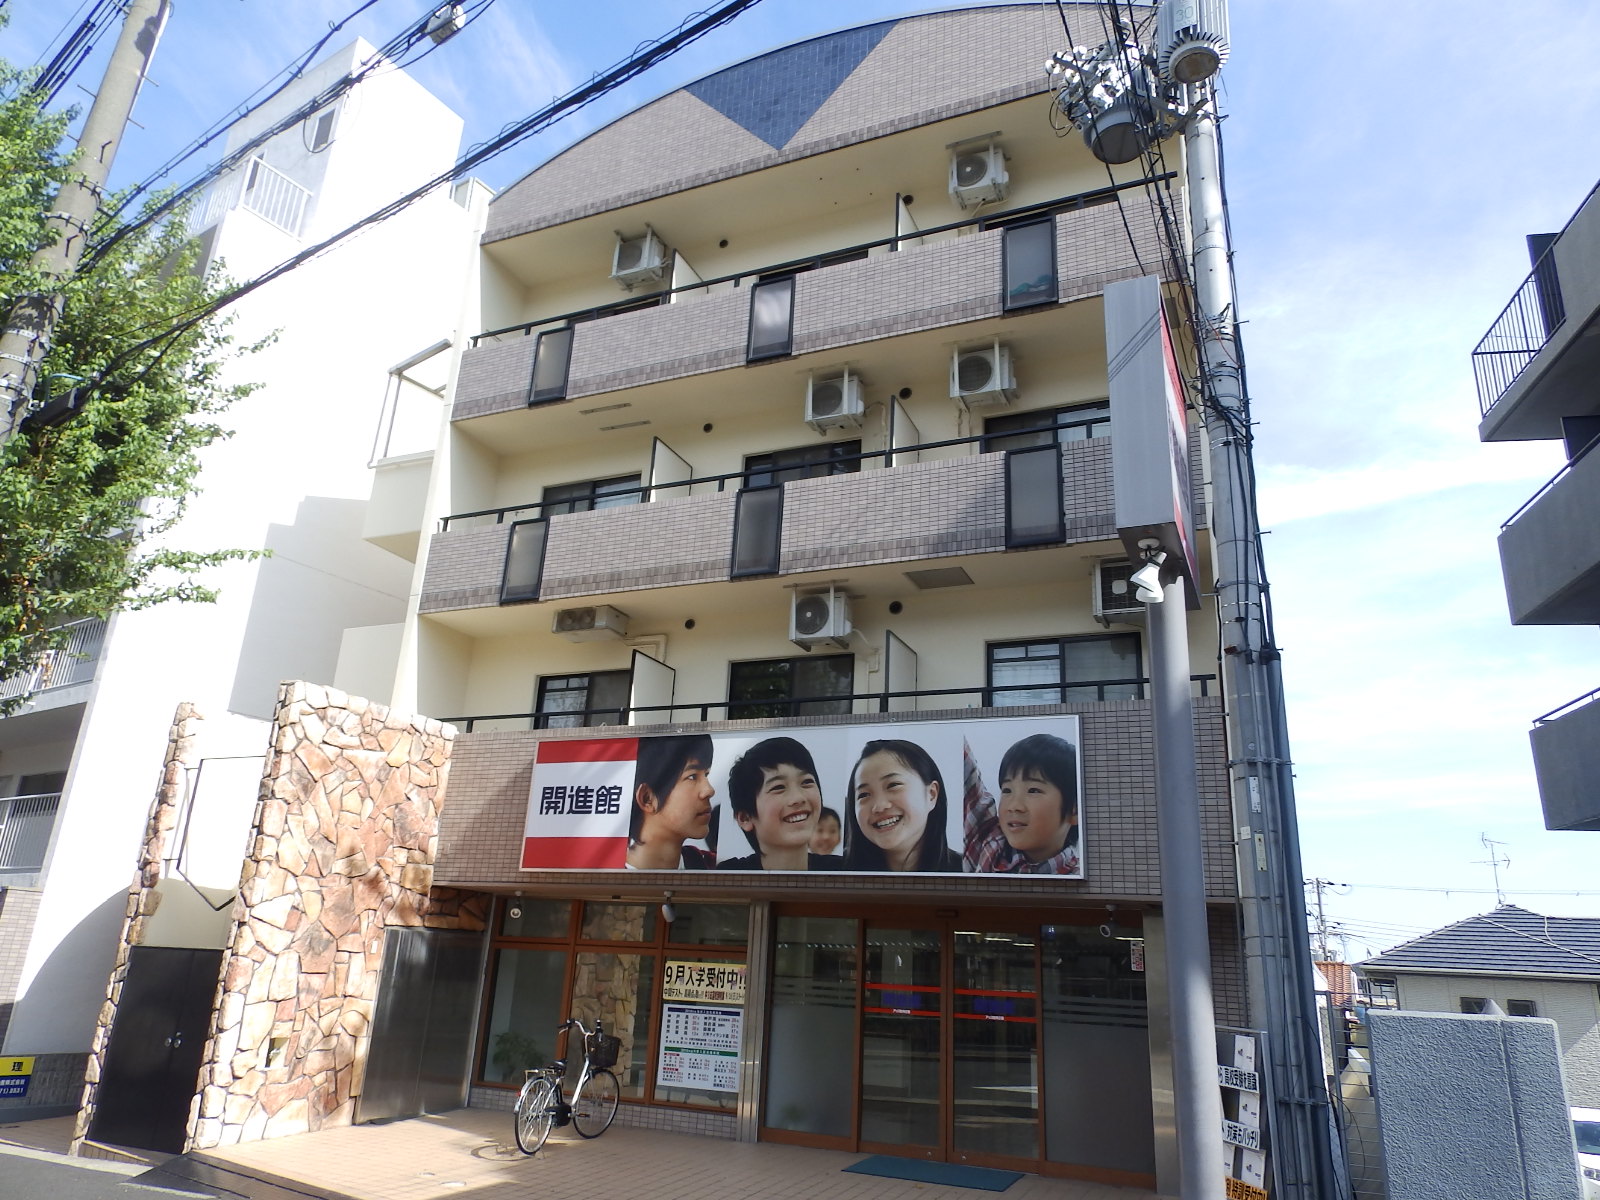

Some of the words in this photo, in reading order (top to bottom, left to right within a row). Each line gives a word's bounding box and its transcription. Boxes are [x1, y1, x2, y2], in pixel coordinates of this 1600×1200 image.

[539, 785, 622, 815] 開進館
[1222, 1120, 1259, 1149] 対策もバッチリ
